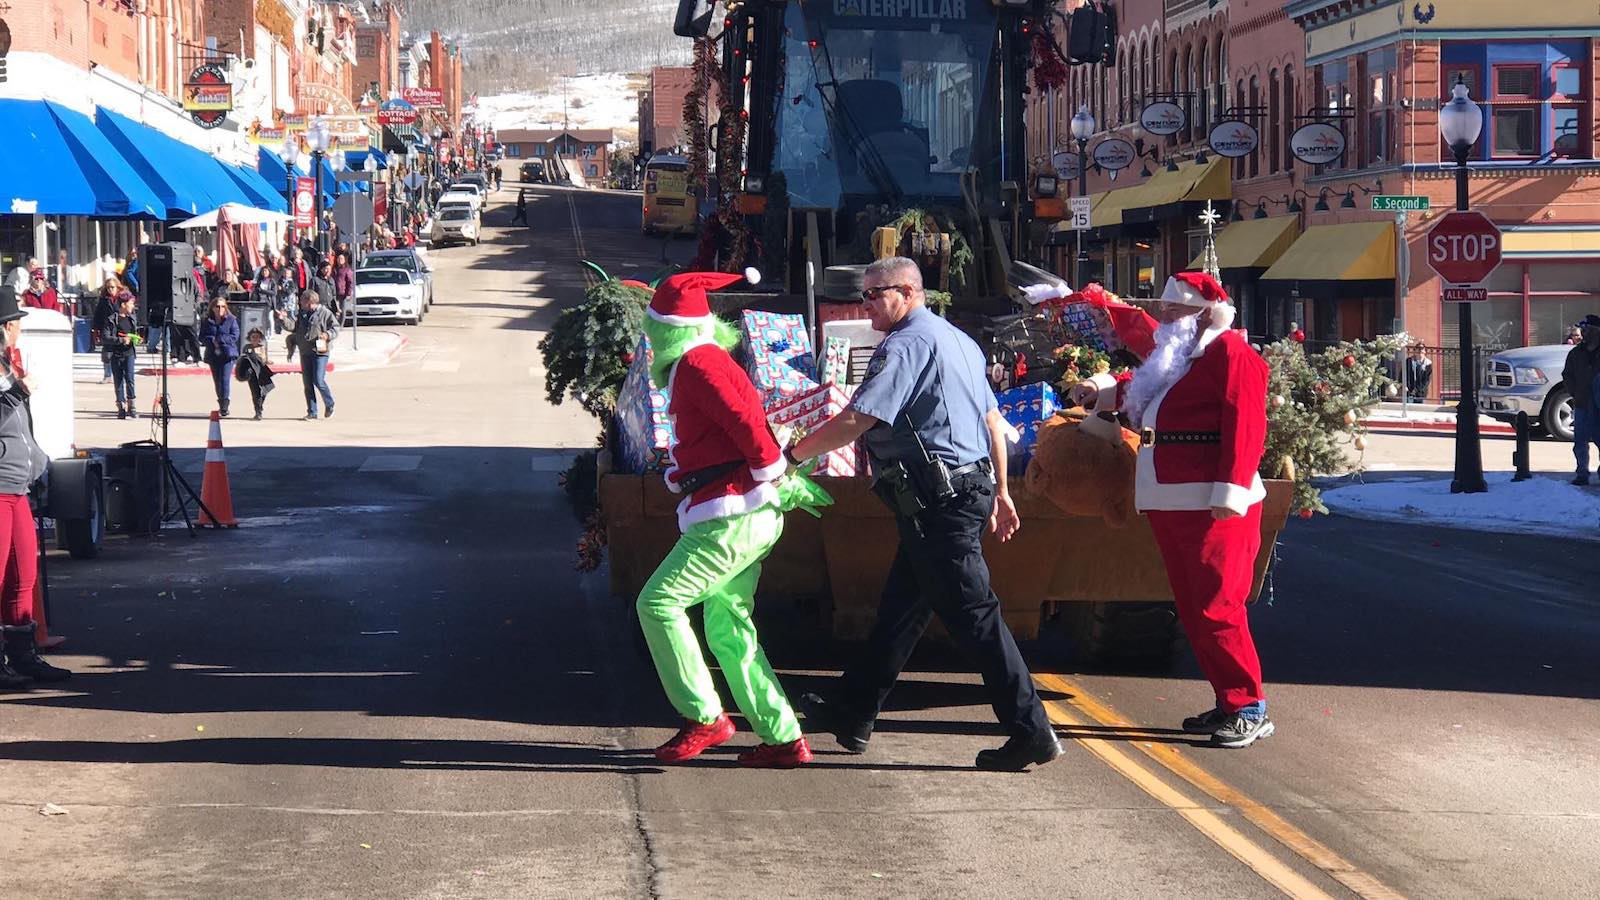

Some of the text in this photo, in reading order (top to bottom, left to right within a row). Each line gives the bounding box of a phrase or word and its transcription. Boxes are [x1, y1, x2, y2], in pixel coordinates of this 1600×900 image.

[833, 0, 966, 18] CATERPILLAR
[193, 66, 222, 79] HOTEL
[403, 87, 441, 98] Christmas
[306, 86, 351, 114] HOME
[378, 110, 416, 118] COTTAGE
[193, 115, 225, 129] CASINO
[1373, 199, 1382, 209] S.
[1385, 198, 1420, 209] Second
[1075, 213, 1088, 226] 15
[1432, 234, 1497, 262] STOP
[1446, 290, 1485, 300] ALL WAY
